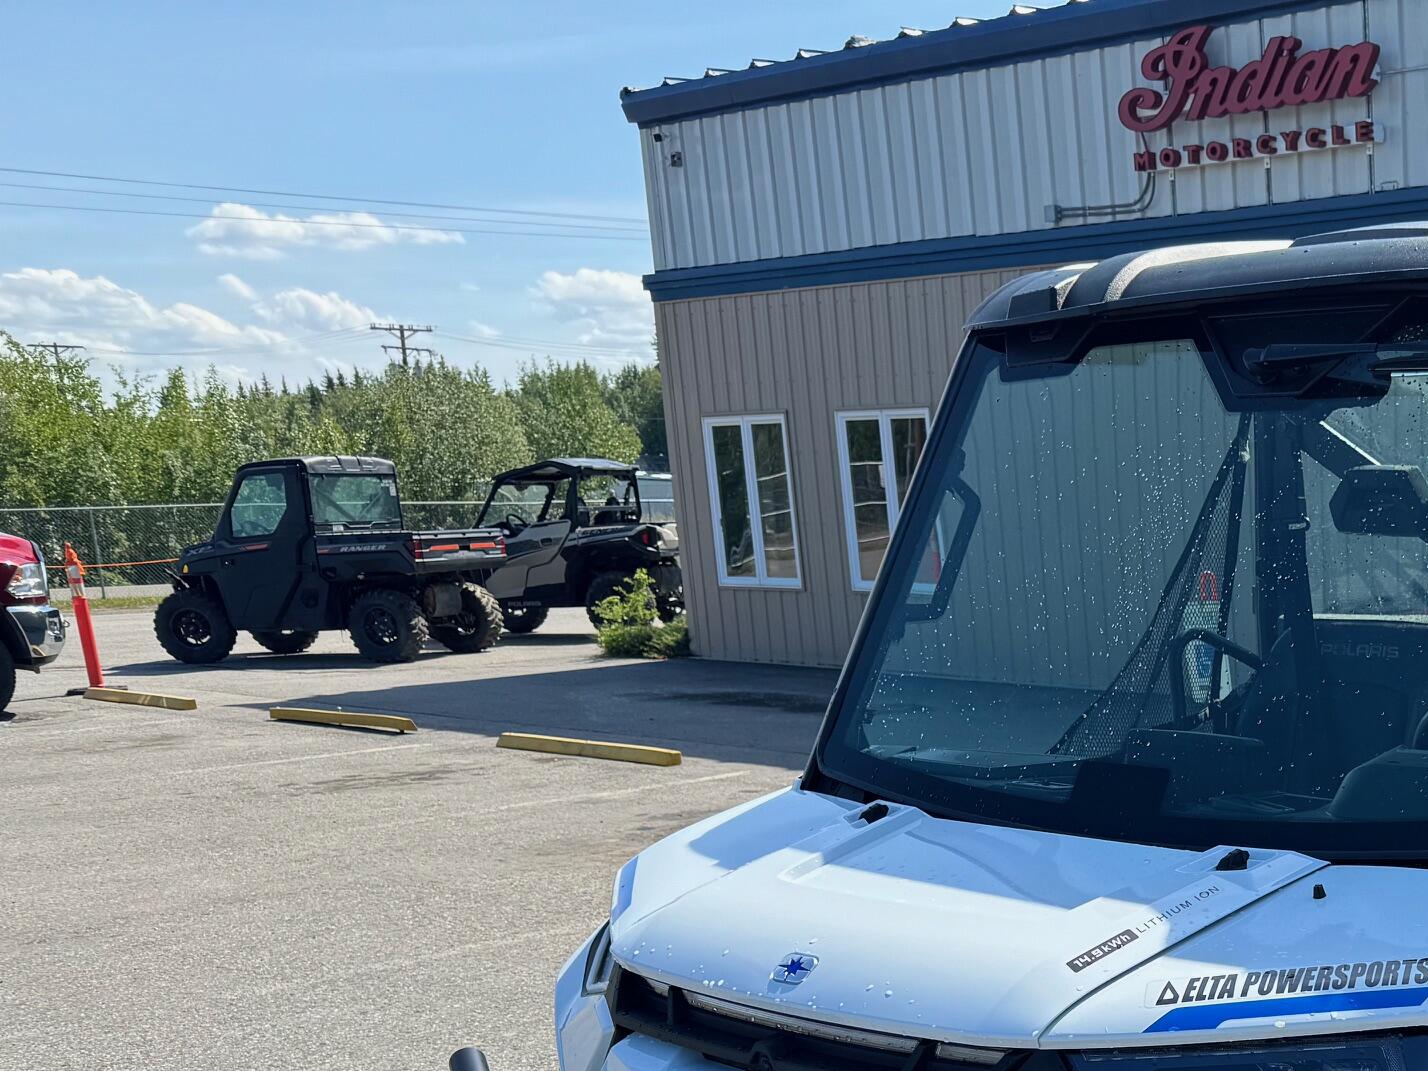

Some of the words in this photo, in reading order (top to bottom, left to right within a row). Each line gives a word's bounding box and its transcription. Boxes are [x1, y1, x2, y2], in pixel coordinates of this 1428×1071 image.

[1118, 25, 1380, 132] Indian
[1133, 120, 1374, 172] MOTORCYCLE
[340, 544, 387, 552] RANGER
[1136, 900, 1192, 933] LITHIUM
[1194, 885, 1220, 901] ION
